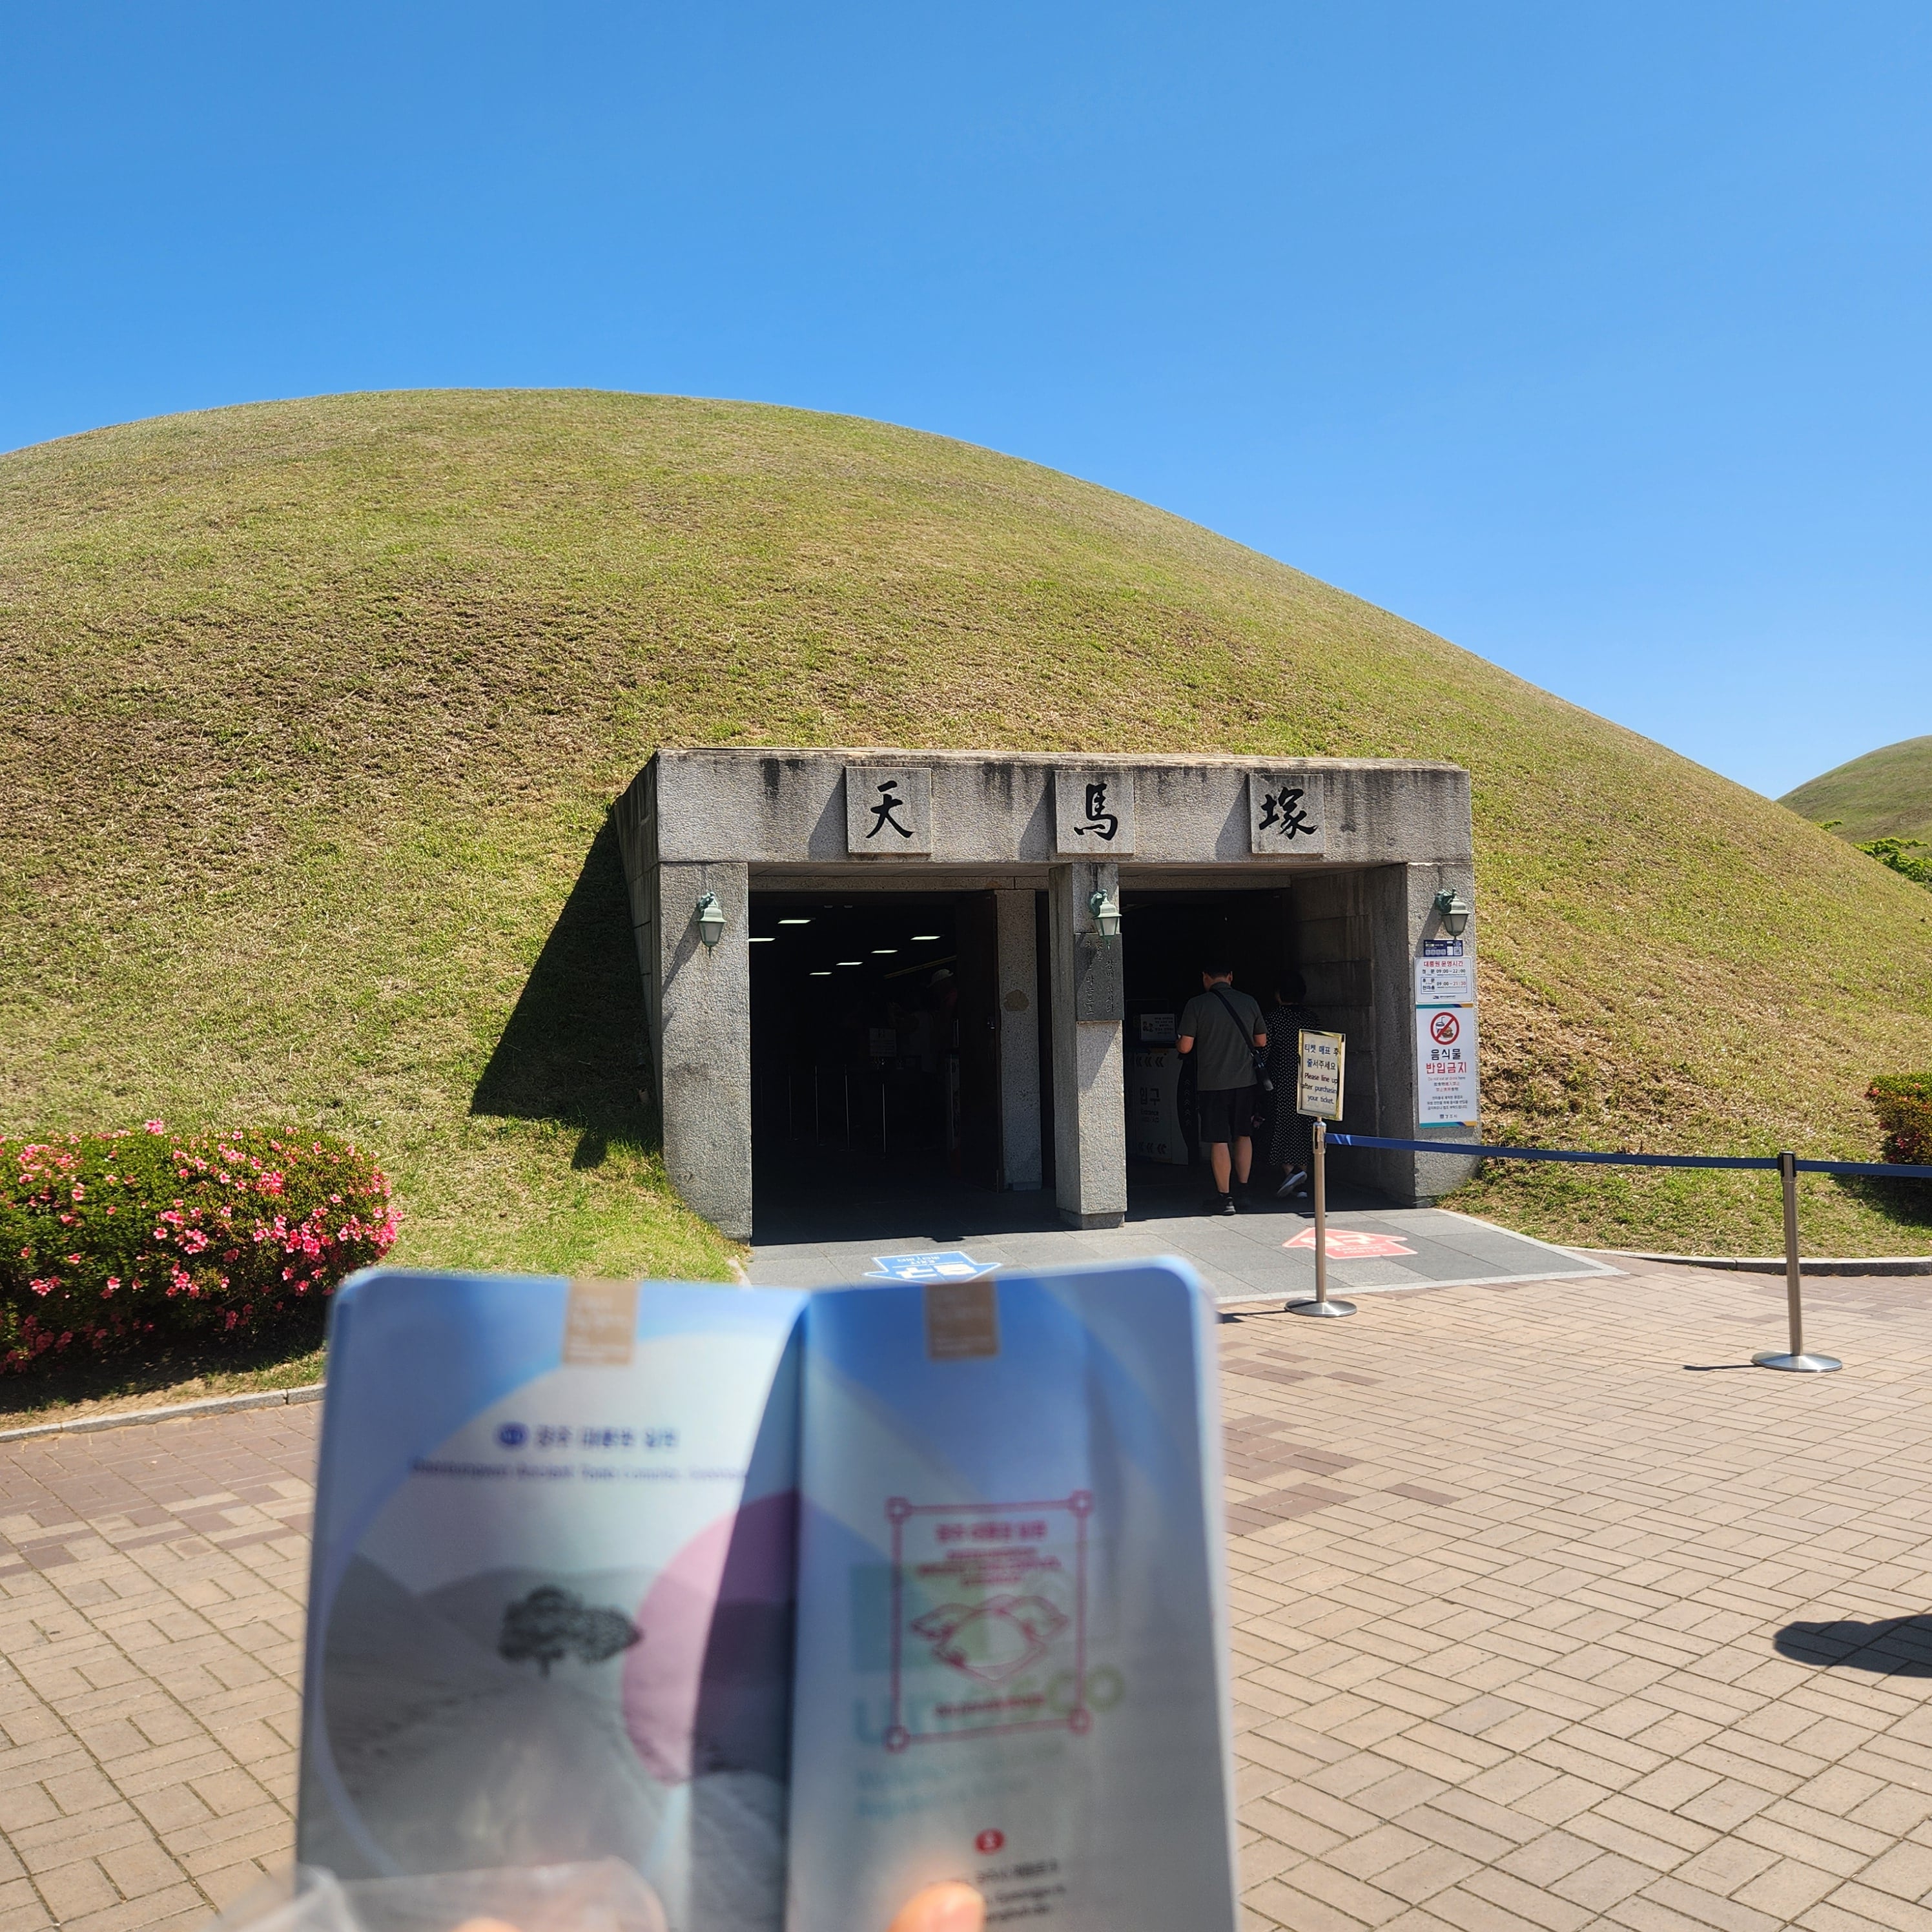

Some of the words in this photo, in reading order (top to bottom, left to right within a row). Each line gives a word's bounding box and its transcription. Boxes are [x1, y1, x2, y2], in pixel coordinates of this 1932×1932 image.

[1304, 1043, 1316, 1054] 티켓
[1333, 1047, 1339, 1056] 후
[1431, 1049, 1461, 1060] 음식물
[1426, 1062, 1467, 1074] 반입금지
[1304, 1072, 1320, 1081] Please
[1321, 1074, 1330, 1083] line
[1315, 1085, 1337, 1095] purchasin
[1140, 1087, 1161, 1106] 입구
[1321, 1096, 1334, 1105] ticket.
